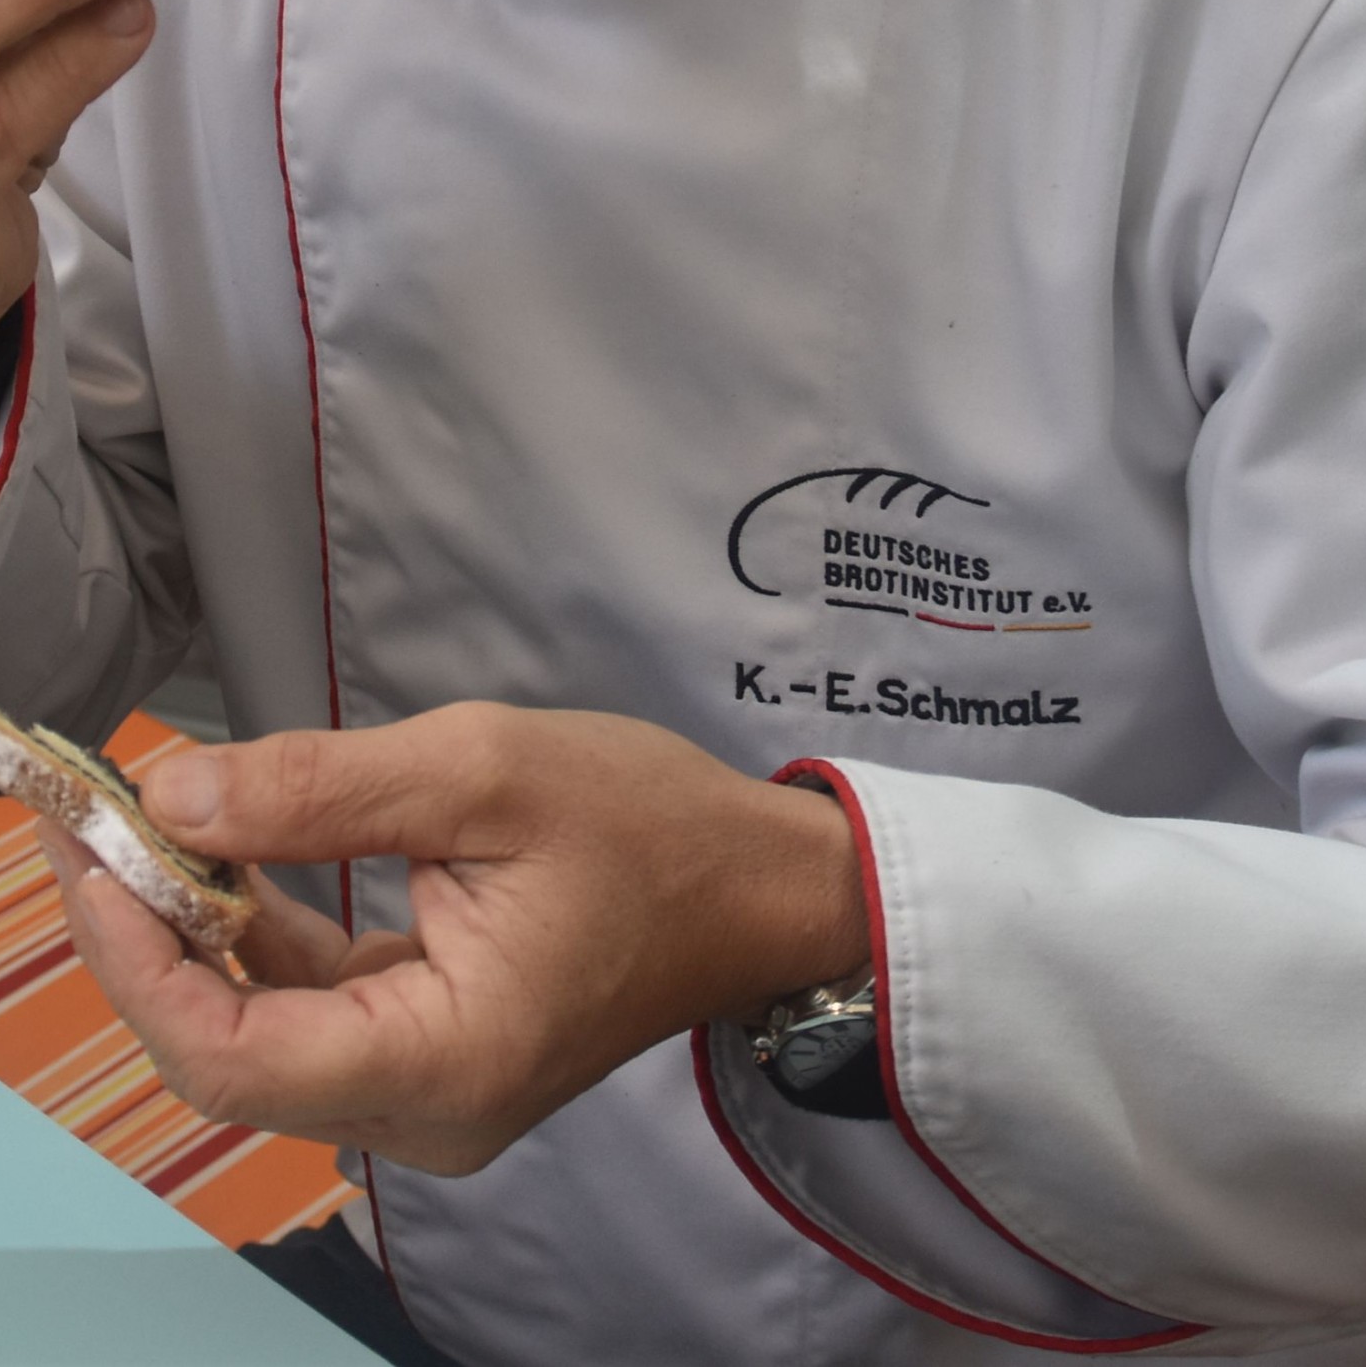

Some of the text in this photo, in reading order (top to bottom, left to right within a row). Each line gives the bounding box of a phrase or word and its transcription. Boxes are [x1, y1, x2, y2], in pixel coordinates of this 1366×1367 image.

[824, 529, 990, 581] DEUTSCHES
[824, 562, 1093, 614] BROTINSTITUT e.V.
